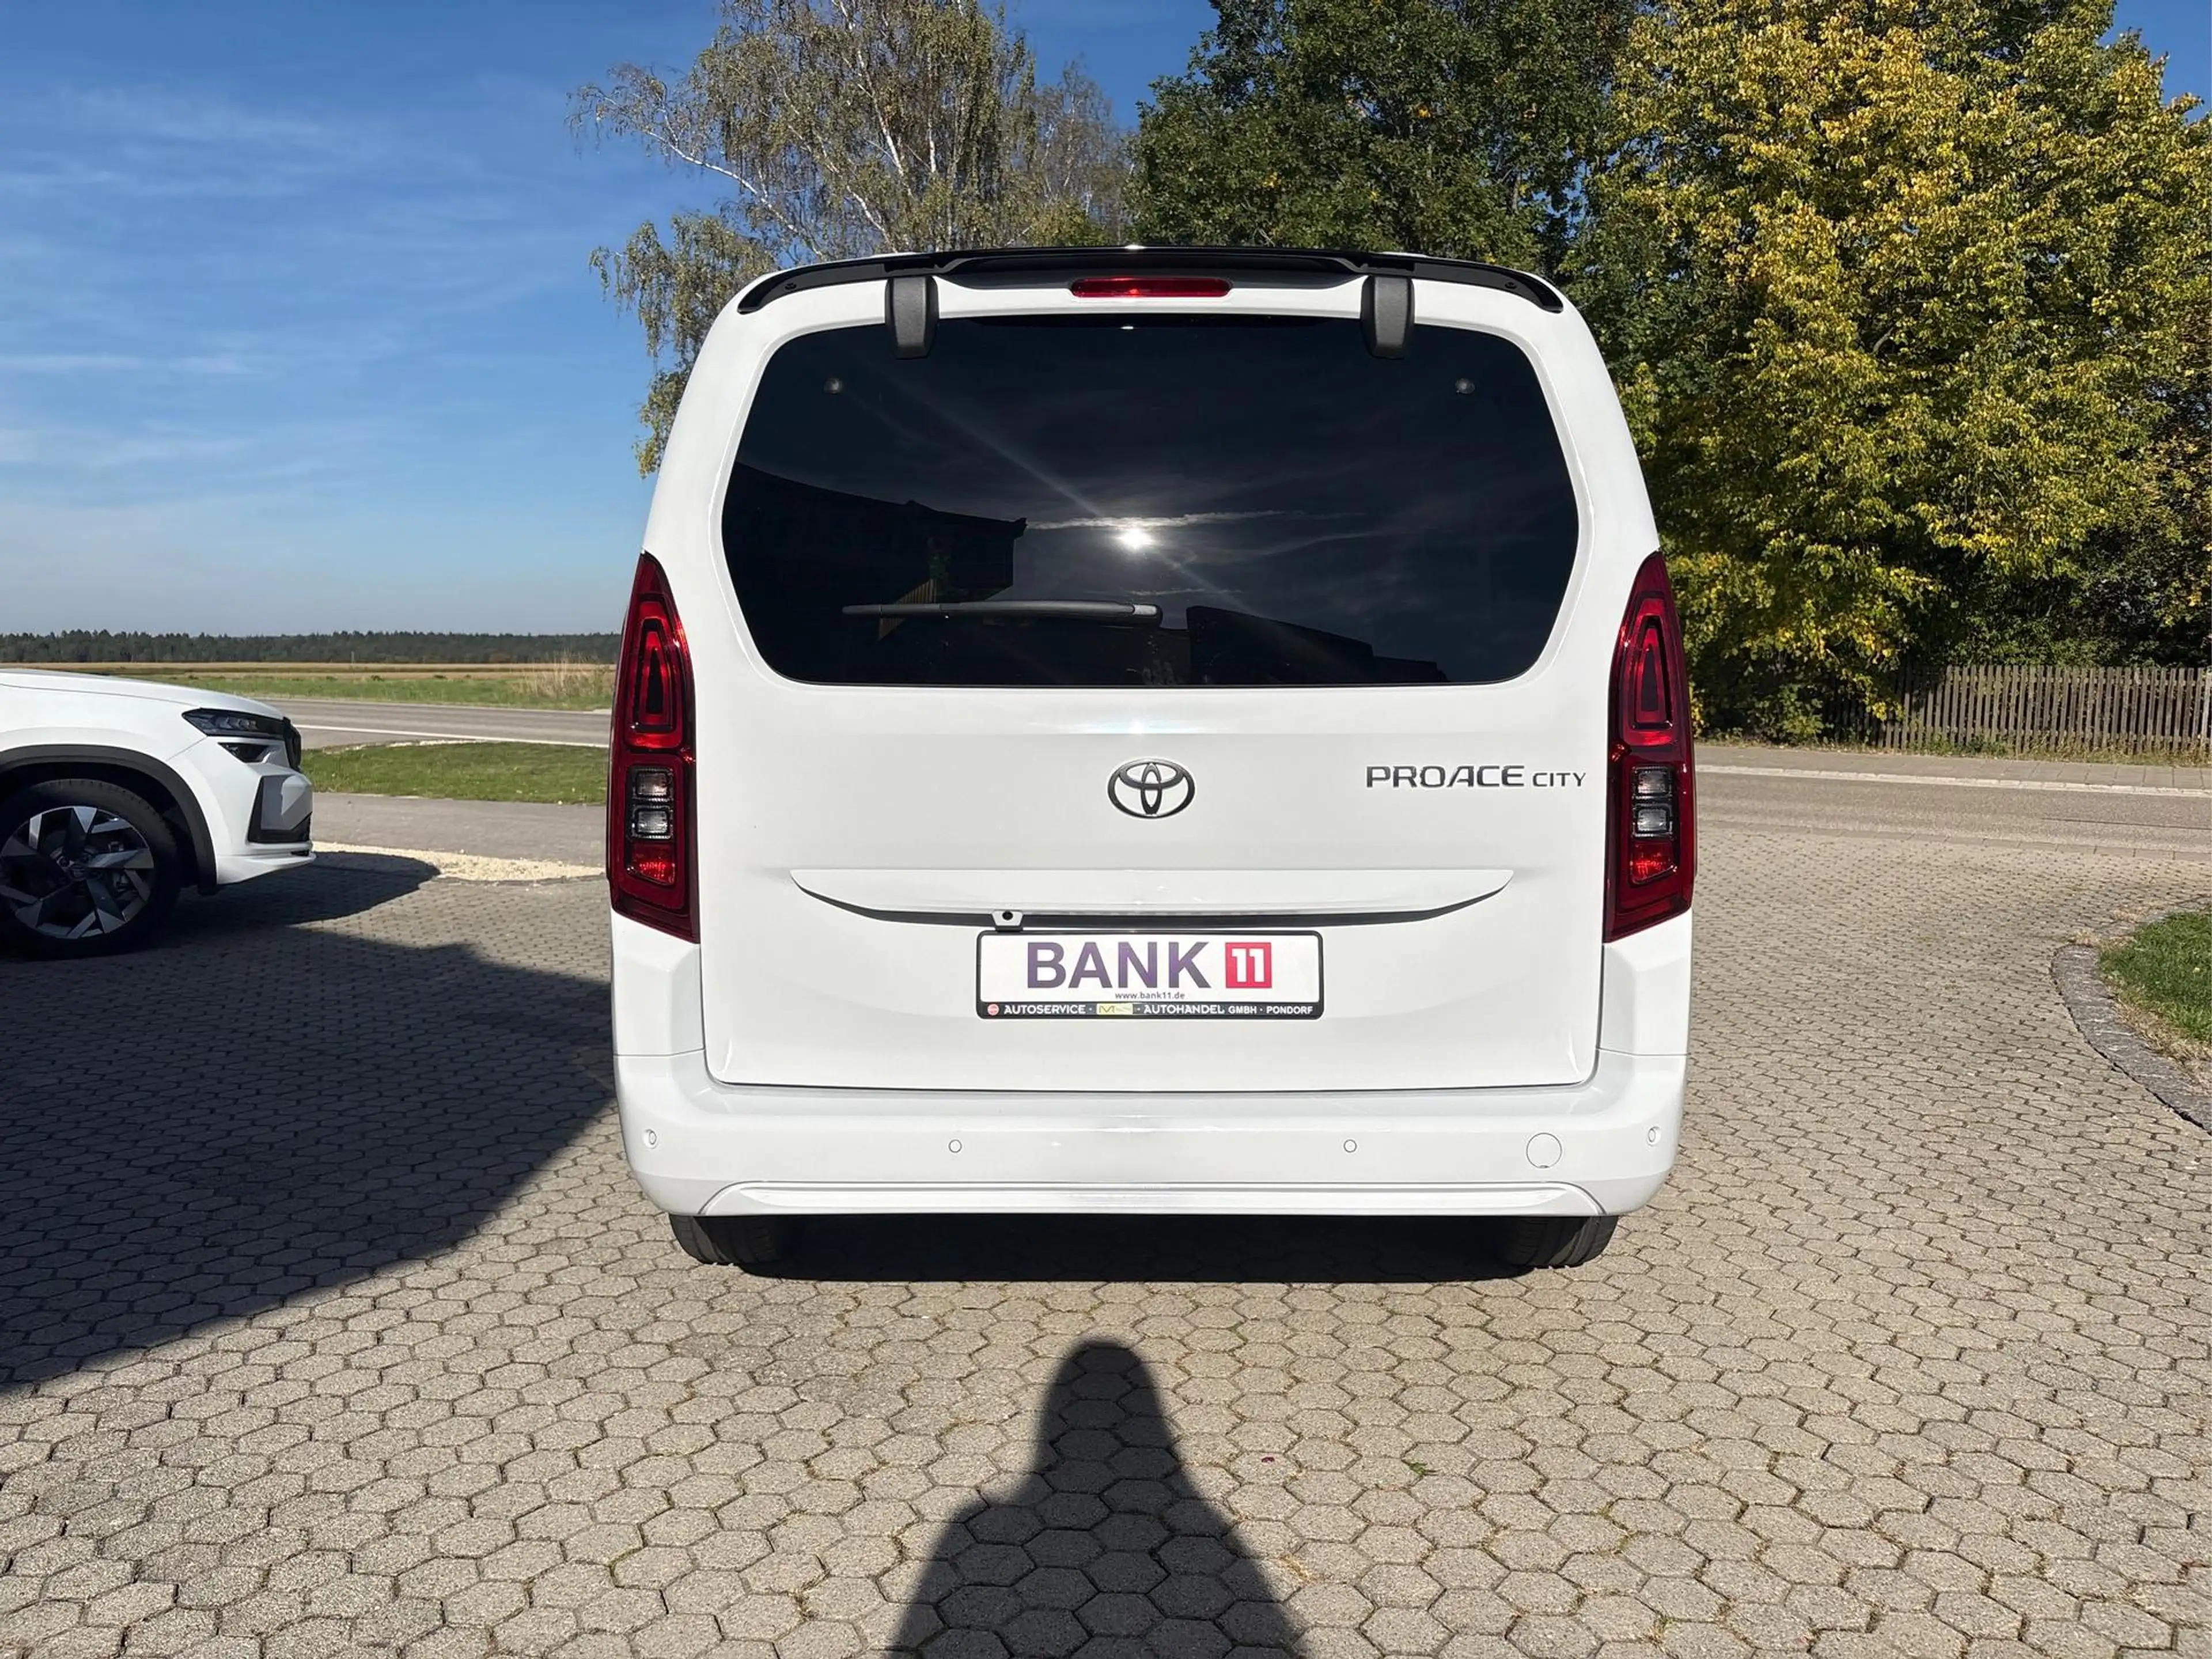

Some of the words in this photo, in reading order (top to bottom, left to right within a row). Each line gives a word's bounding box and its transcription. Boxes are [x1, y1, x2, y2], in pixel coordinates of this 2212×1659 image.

[1366, 765, 1525, 788] PROACE
[1532, 772, 1586, 787] CITY
[1027, 941, 1211, 988] BANK
[1232, 948, 1265, 983] 11
[1115, 991, 1185, 999] www.bank11.de
[1003, 1004, 1086, 1015] AUTOSERVICE
[1142, 1004, 1225, 1015] AUTOHANDEL
[1228, 1005, 1258, 1015] GMBH
[1266, 1005, 1314, 1015] PONDORF
